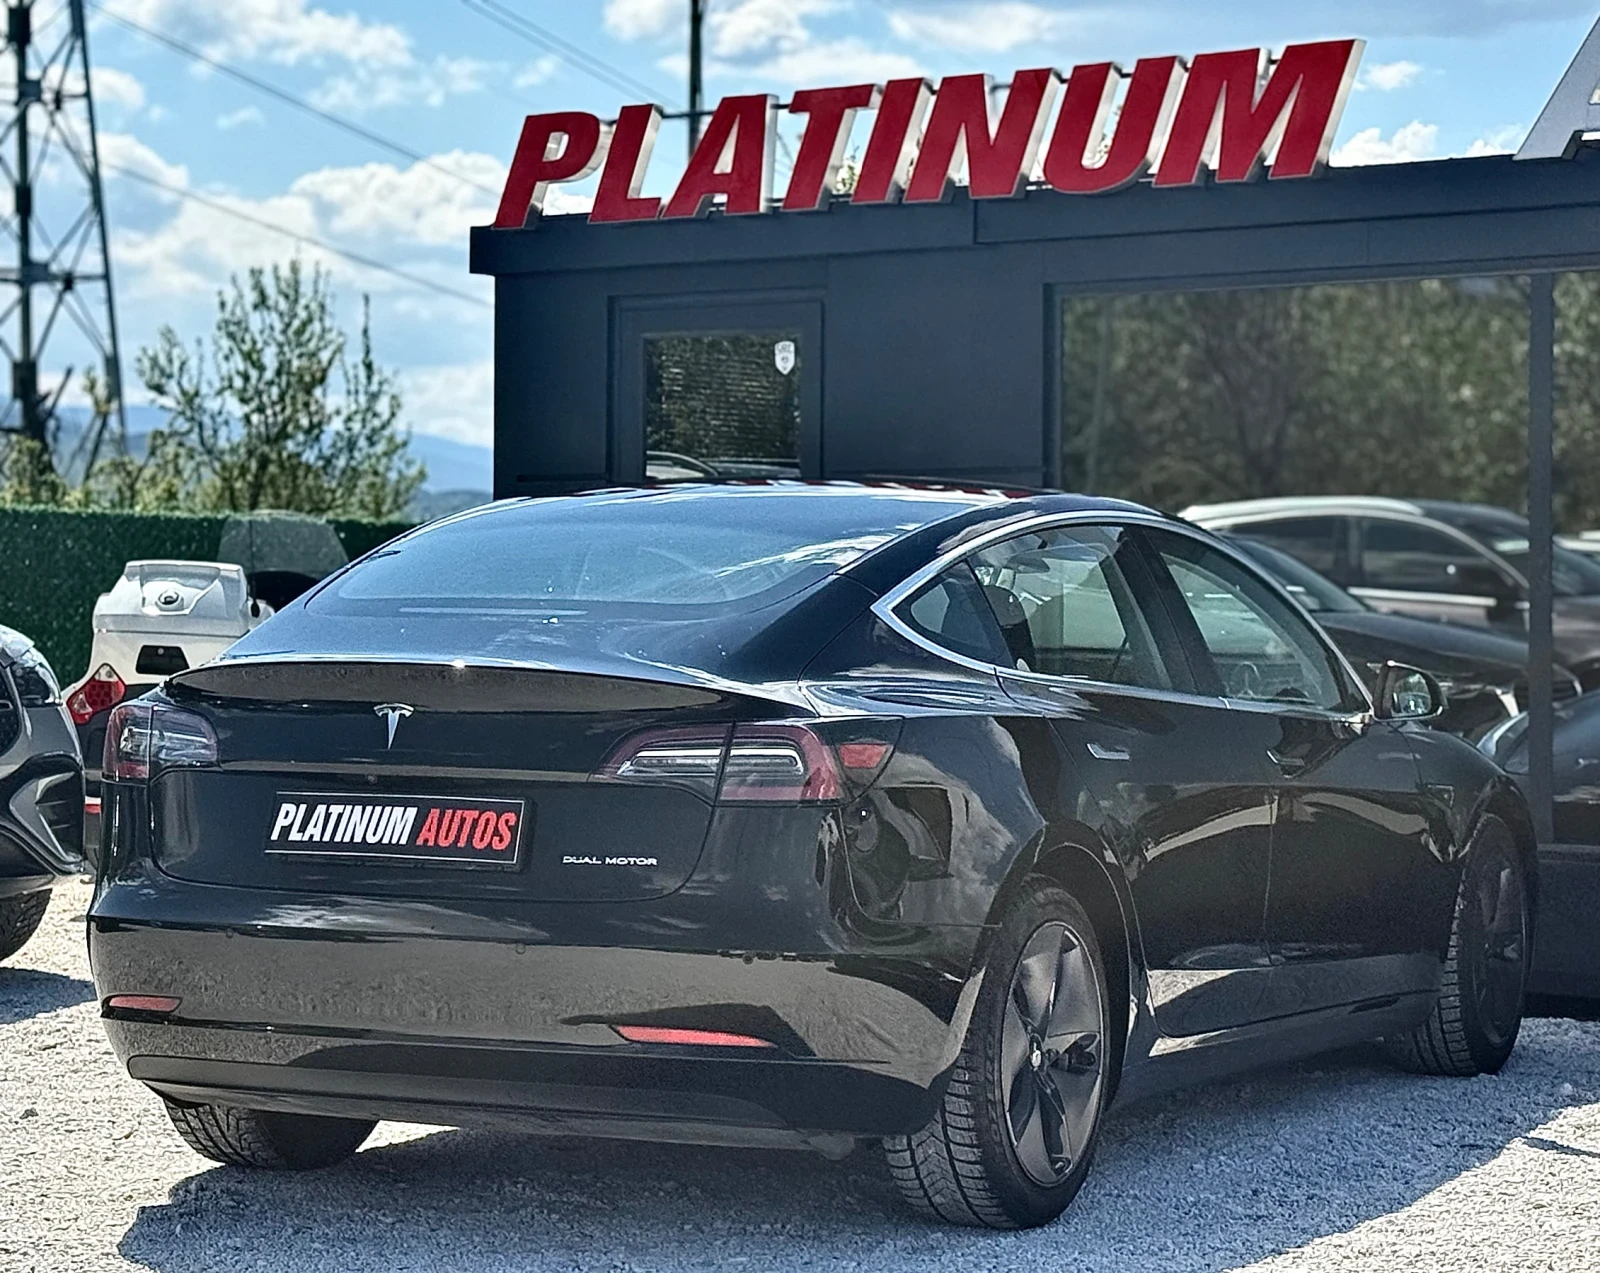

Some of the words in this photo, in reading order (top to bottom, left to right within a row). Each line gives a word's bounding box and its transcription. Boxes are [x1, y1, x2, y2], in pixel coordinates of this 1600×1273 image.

[493, 39, 1360, 229] PLATINUM
[270, 802, 418, 845] PLATINUM
[416, 808, 516, 850] AUTOS
[562, 855, 602, 865] DUAL
[605, 856, 658, 866] MOTOR
